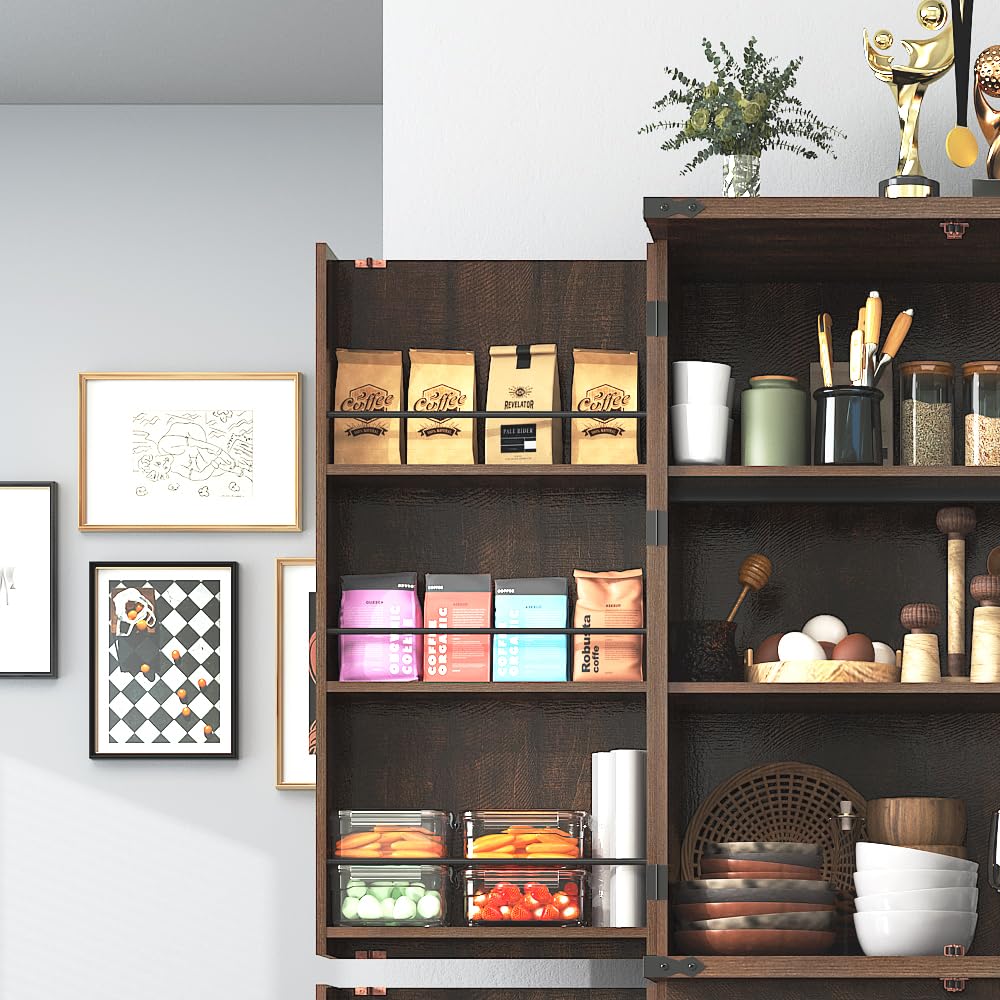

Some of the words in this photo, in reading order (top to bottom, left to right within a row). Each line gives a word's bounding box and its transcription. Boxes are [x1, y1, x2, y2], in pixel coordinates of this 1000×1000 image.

[341, 391, 394, 412] Coffee
[413, 391, 467, 412] Coffee
[504, 400, 534, 410] REVELATOR
[577, 391, 631, 412] Coffee
[402, 618, 413, 675] COFFE
[428, 619, 437, 676] COFFE
[581, 614, 592, 673] Robuta
[592, 645, 600, 673] coffe
